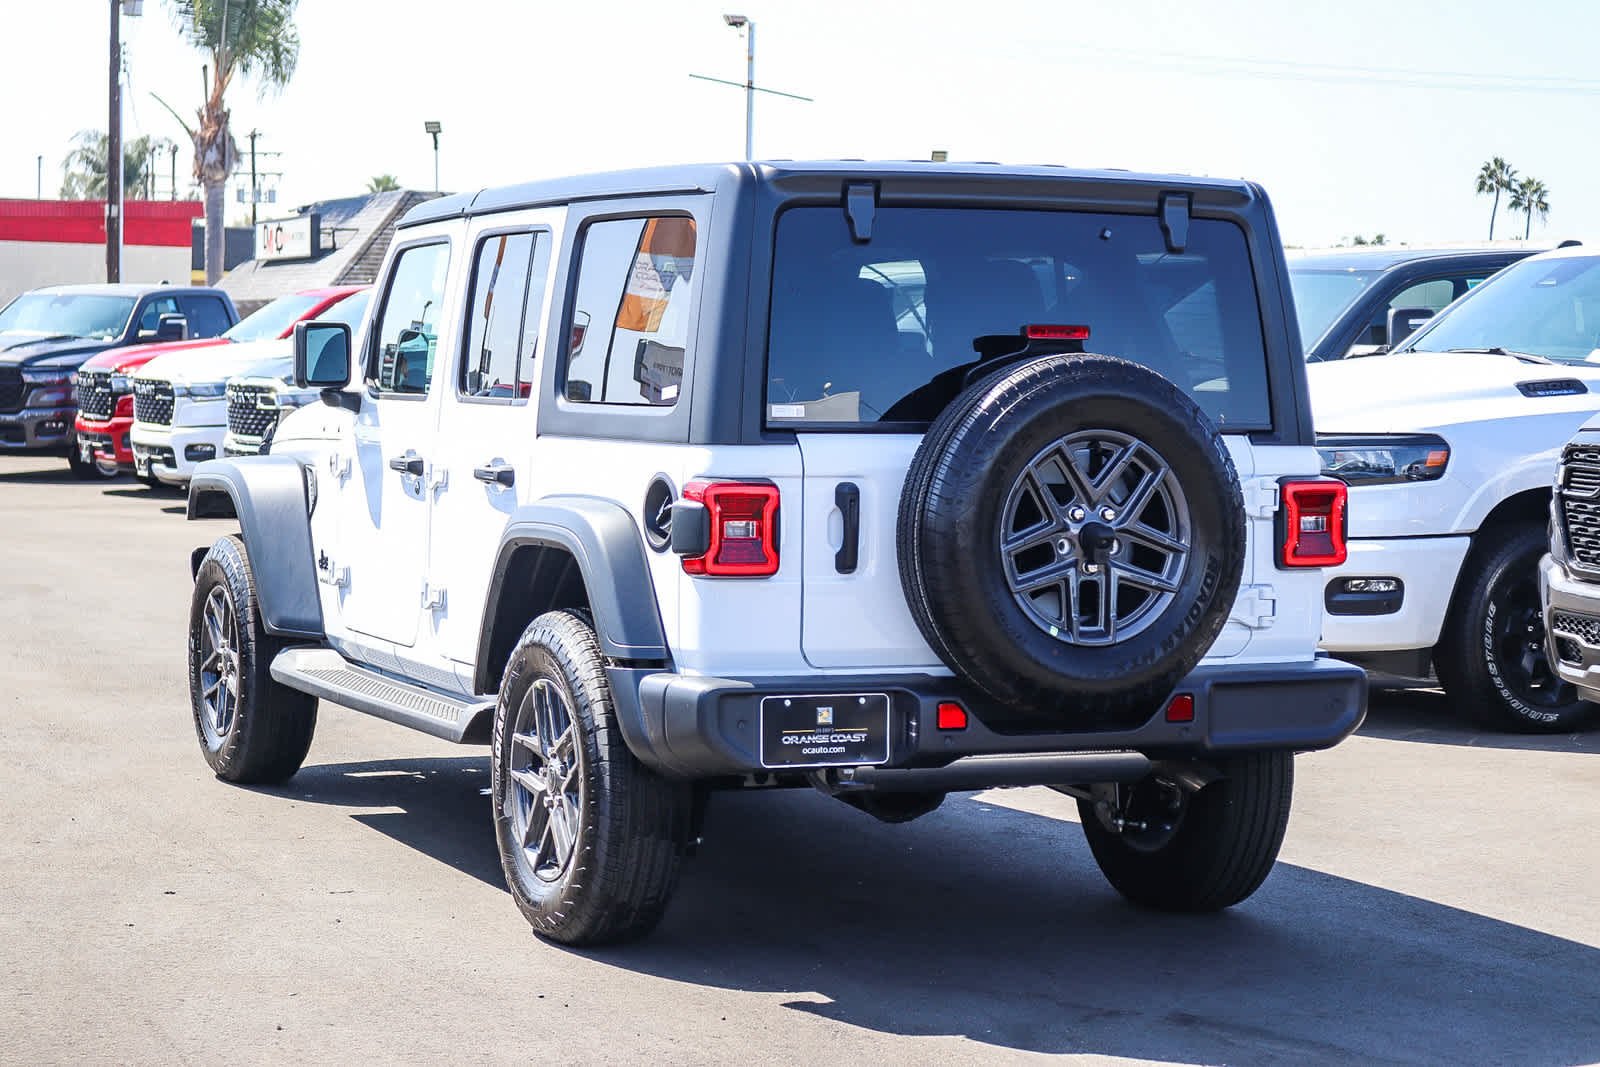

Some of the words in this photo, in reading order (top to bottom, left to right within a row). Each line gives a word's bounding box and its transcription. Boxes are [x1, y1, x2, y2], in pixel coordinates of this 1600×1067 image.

[782, 734, 830, 745] ORANGE
[830, 733, 868, 743] COAST
[802, 746, 846, 754] ocauto.com
